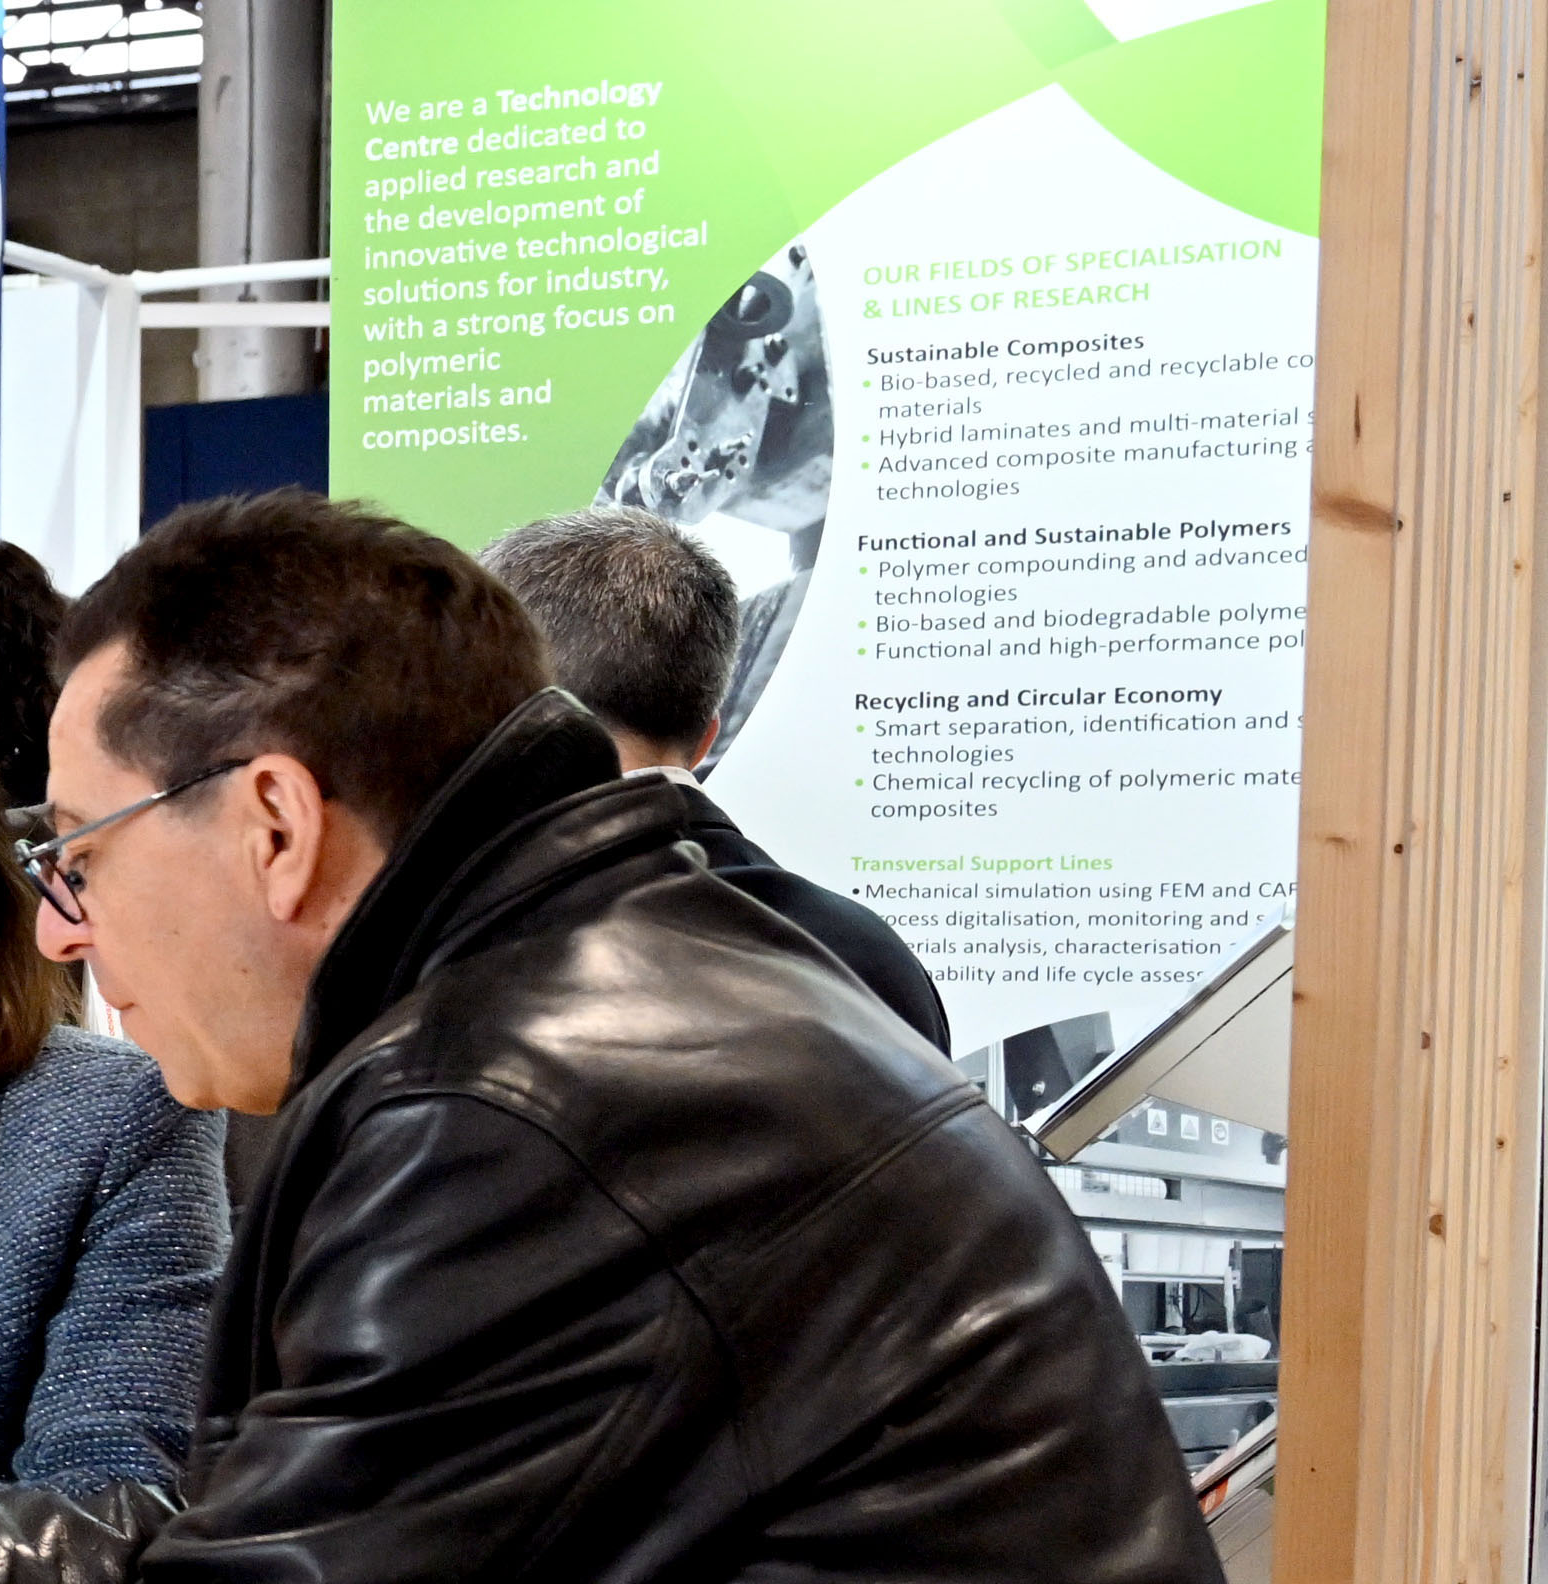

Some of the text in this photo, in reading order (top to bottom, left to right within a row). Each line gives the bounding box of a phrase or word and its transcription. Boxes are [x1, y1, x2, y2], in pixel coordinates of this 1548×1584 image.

[365, 78, 662, 125] We are a Technology
[364, 116, 647, 161] Centre dedicated to
[365, 149, 660, 202] applied research and
[364, 186, 645, 234] the development of
[364, 220, 708, 270] innovative technological
[862, 239, 1282, 286] OUR FIELDS OF SPECIALISATION
[363, 266, 670, 306] solutions for industry,
[862, 282, 1150, 320] & LINES OF RESEARCH
[363, 303, 676, 342] with a strong focus on
[363, 346, 501, 381] polymeric
[867, 333, 1145, 366] Sustainable Composites
[881, 351, 1279, 392] Bio-based, recycled and recyclable
[363, 378, 552, 414] materials and
[879, 396, 982, 419] materials
[362, 420, 528, 452] composites.
[879, 406, 1299, 450] Hybrid laminates and multi-material
[878, 437, 1298, 474] Advanced composite manufacturing
[876, 478, 1020, 501] technologies
[857, 519, 1292, 552] Functional and Sustainable Polymers
[879, 544, 1307, 582] Polymer compounding and advanced
[875, 584, 1018, 607] technologies
[855, 686, 1223, 714] Recycling and Circular Economy
[850, 854, 1113, 875] Transversal Support Lines
